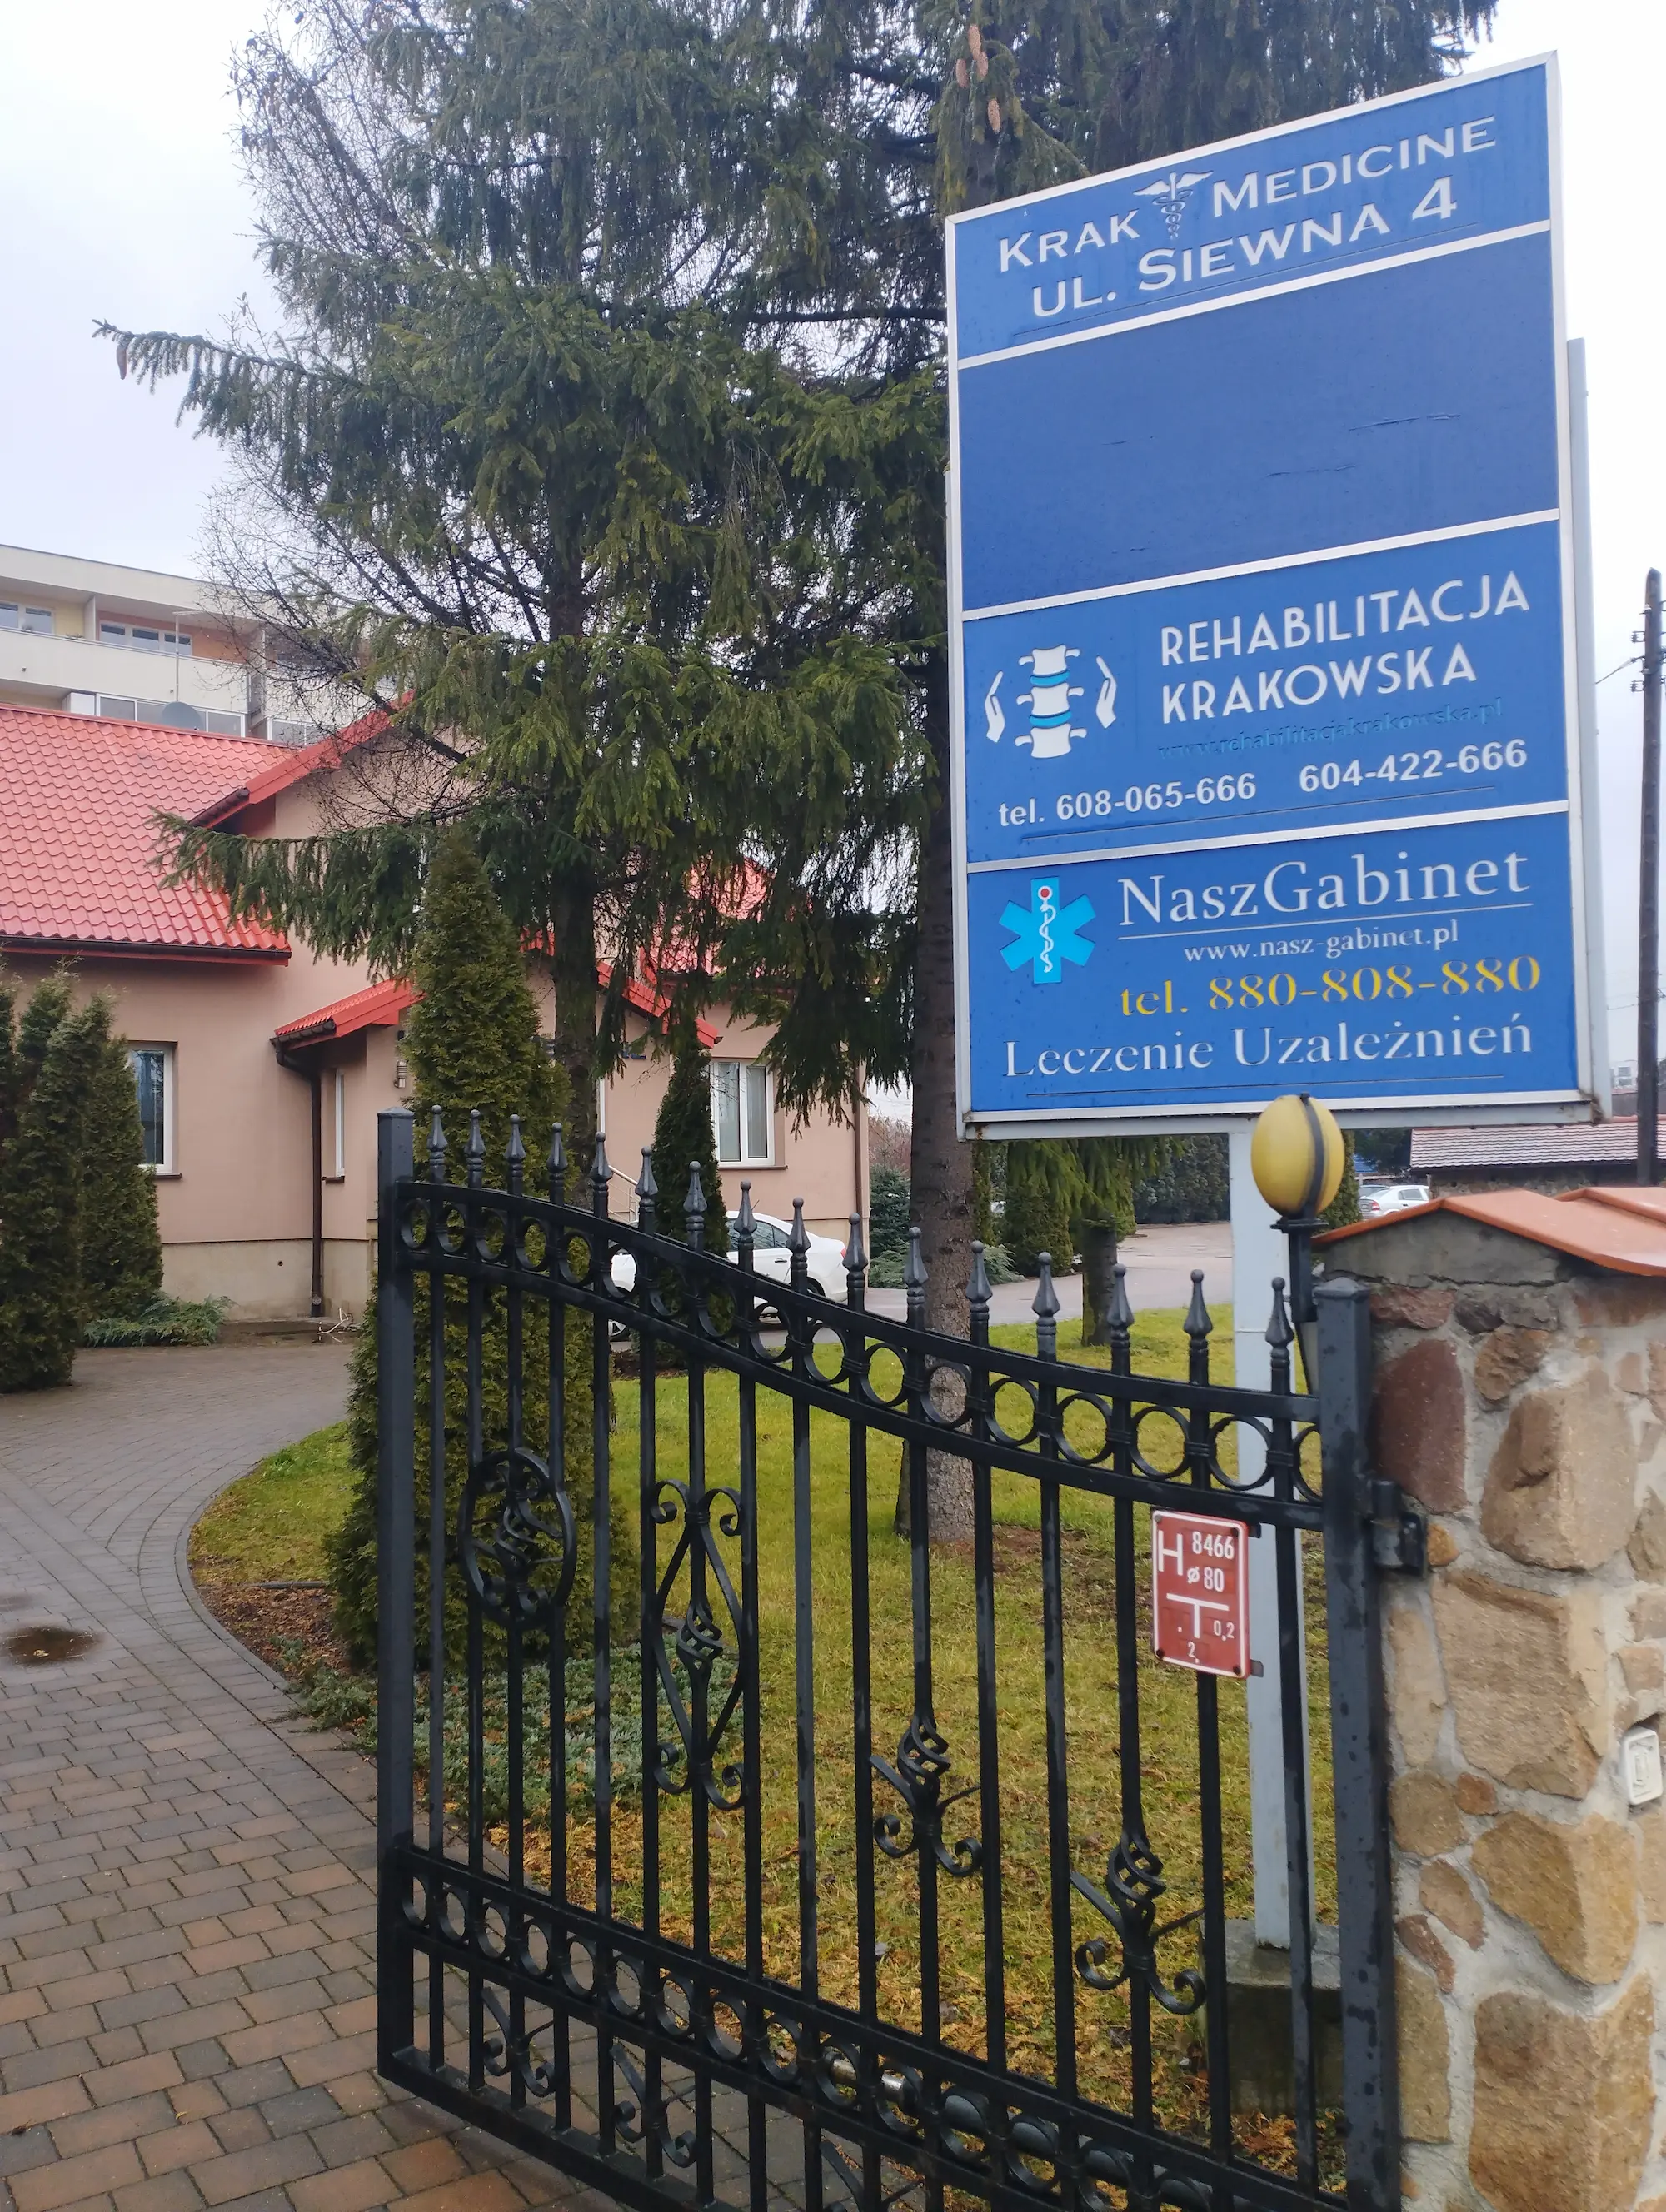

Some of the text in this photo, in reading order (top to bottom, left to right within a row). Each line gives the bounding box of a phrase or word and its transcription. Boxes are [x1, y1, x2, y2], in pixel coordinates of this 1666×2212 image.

[1000, 116, 1497, 272] KRAK MEDICINE
[1032, 176, 1459, 317] UL. SIEWNA 4
[1160, 570, 1530, 666] REHABILITACJA
[1161, 642, 1478, 724] KRAKOWSKA
[1299, 739, 1528, 793] 604-422-666
[999, 772, 1257, 827] tel. 608-065-666
[1117, 851, 1529, 926] NaszGabinet
[1184, 919, 1459, 961] www.nasz-gabinet.pl
[1120, 955, 1541, 1016] tel. 880-808-880
[1002, 1012, 1533, 1077] Leczenie Uzależnień
[1158, 1530, 1235, 1576] H 8466
